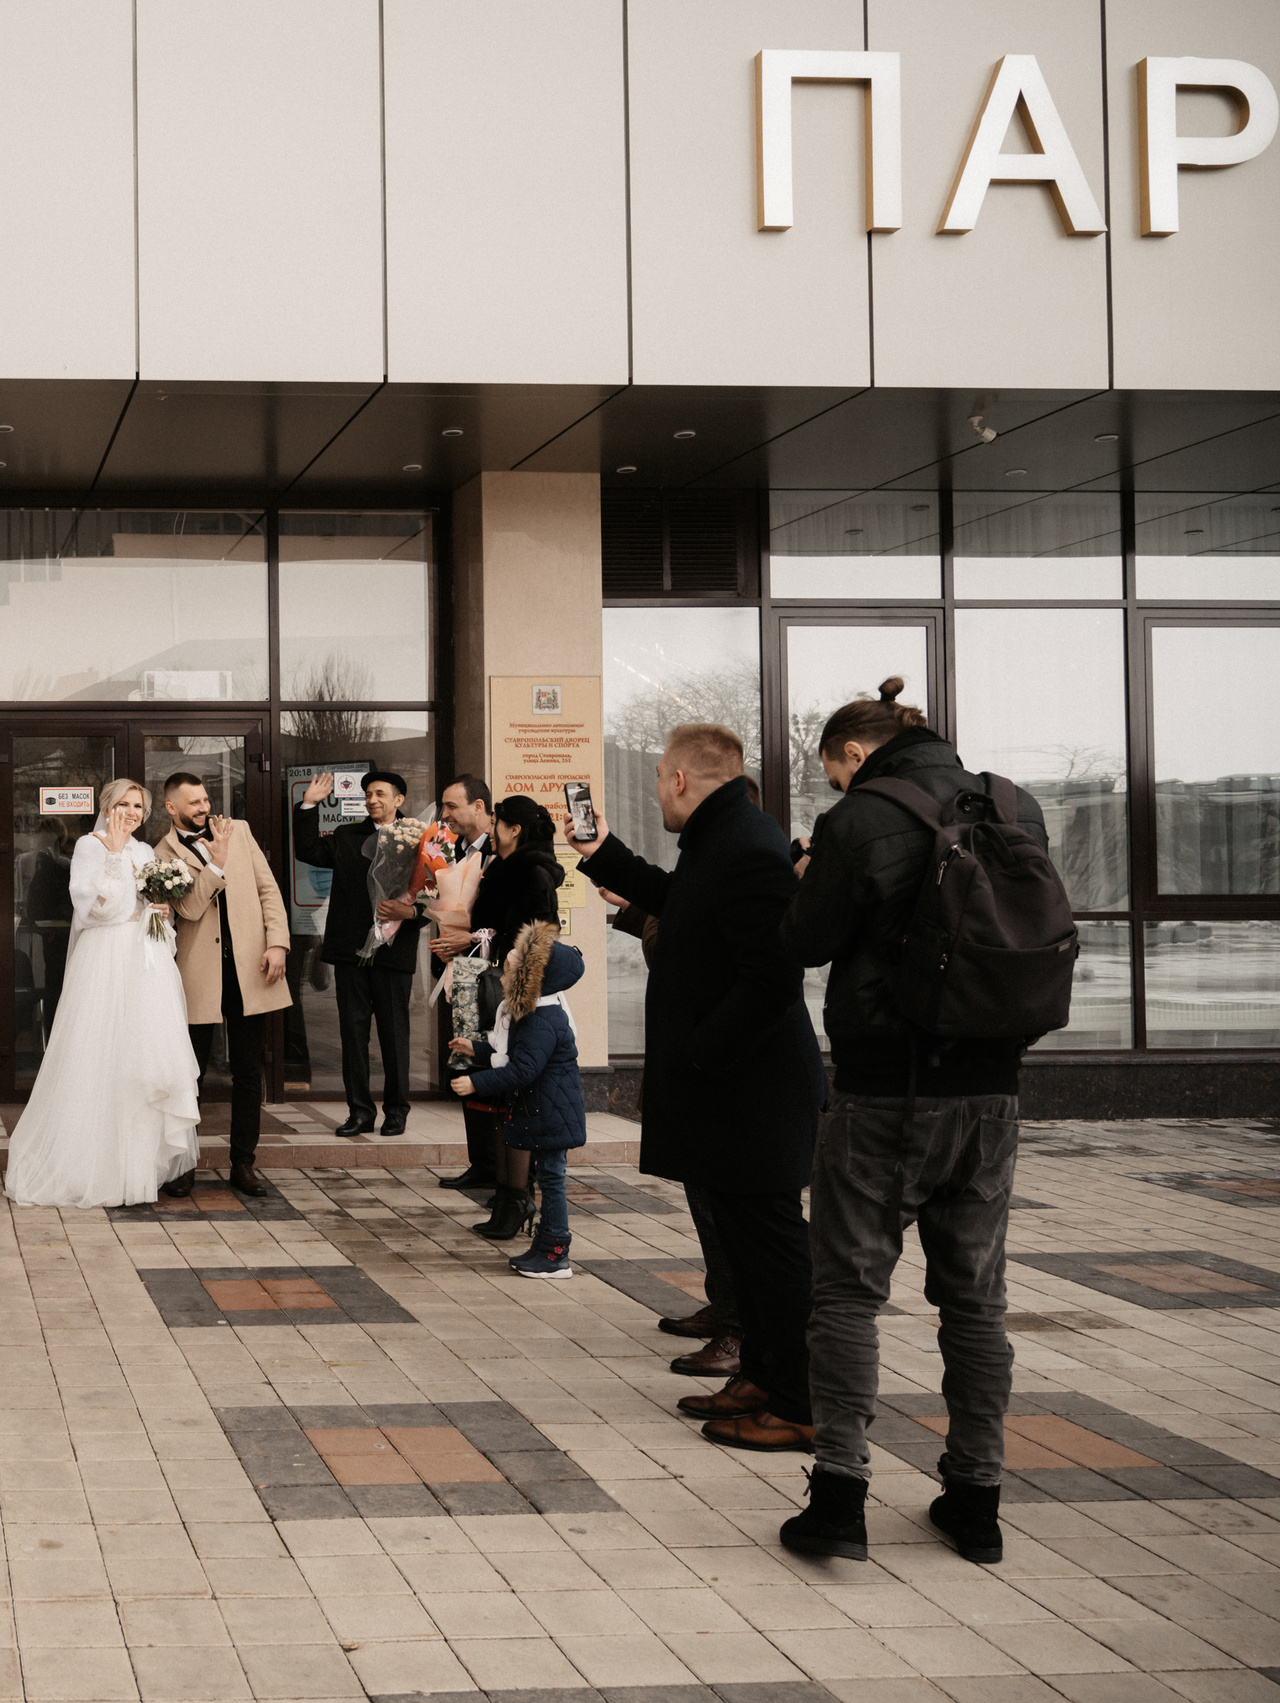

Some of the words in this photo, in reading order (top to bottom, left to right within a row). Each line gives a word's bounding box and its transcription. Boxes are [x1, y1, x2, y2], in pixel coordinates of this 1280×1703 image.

[754, 49, 1279, 237] ПАР
[289, 768, 312, 777] 20:18
[504, 782, 535, 793] ДОМ
[544, 802, 568, 810] работ
[322, 813, 356, 824] МАСКИ
